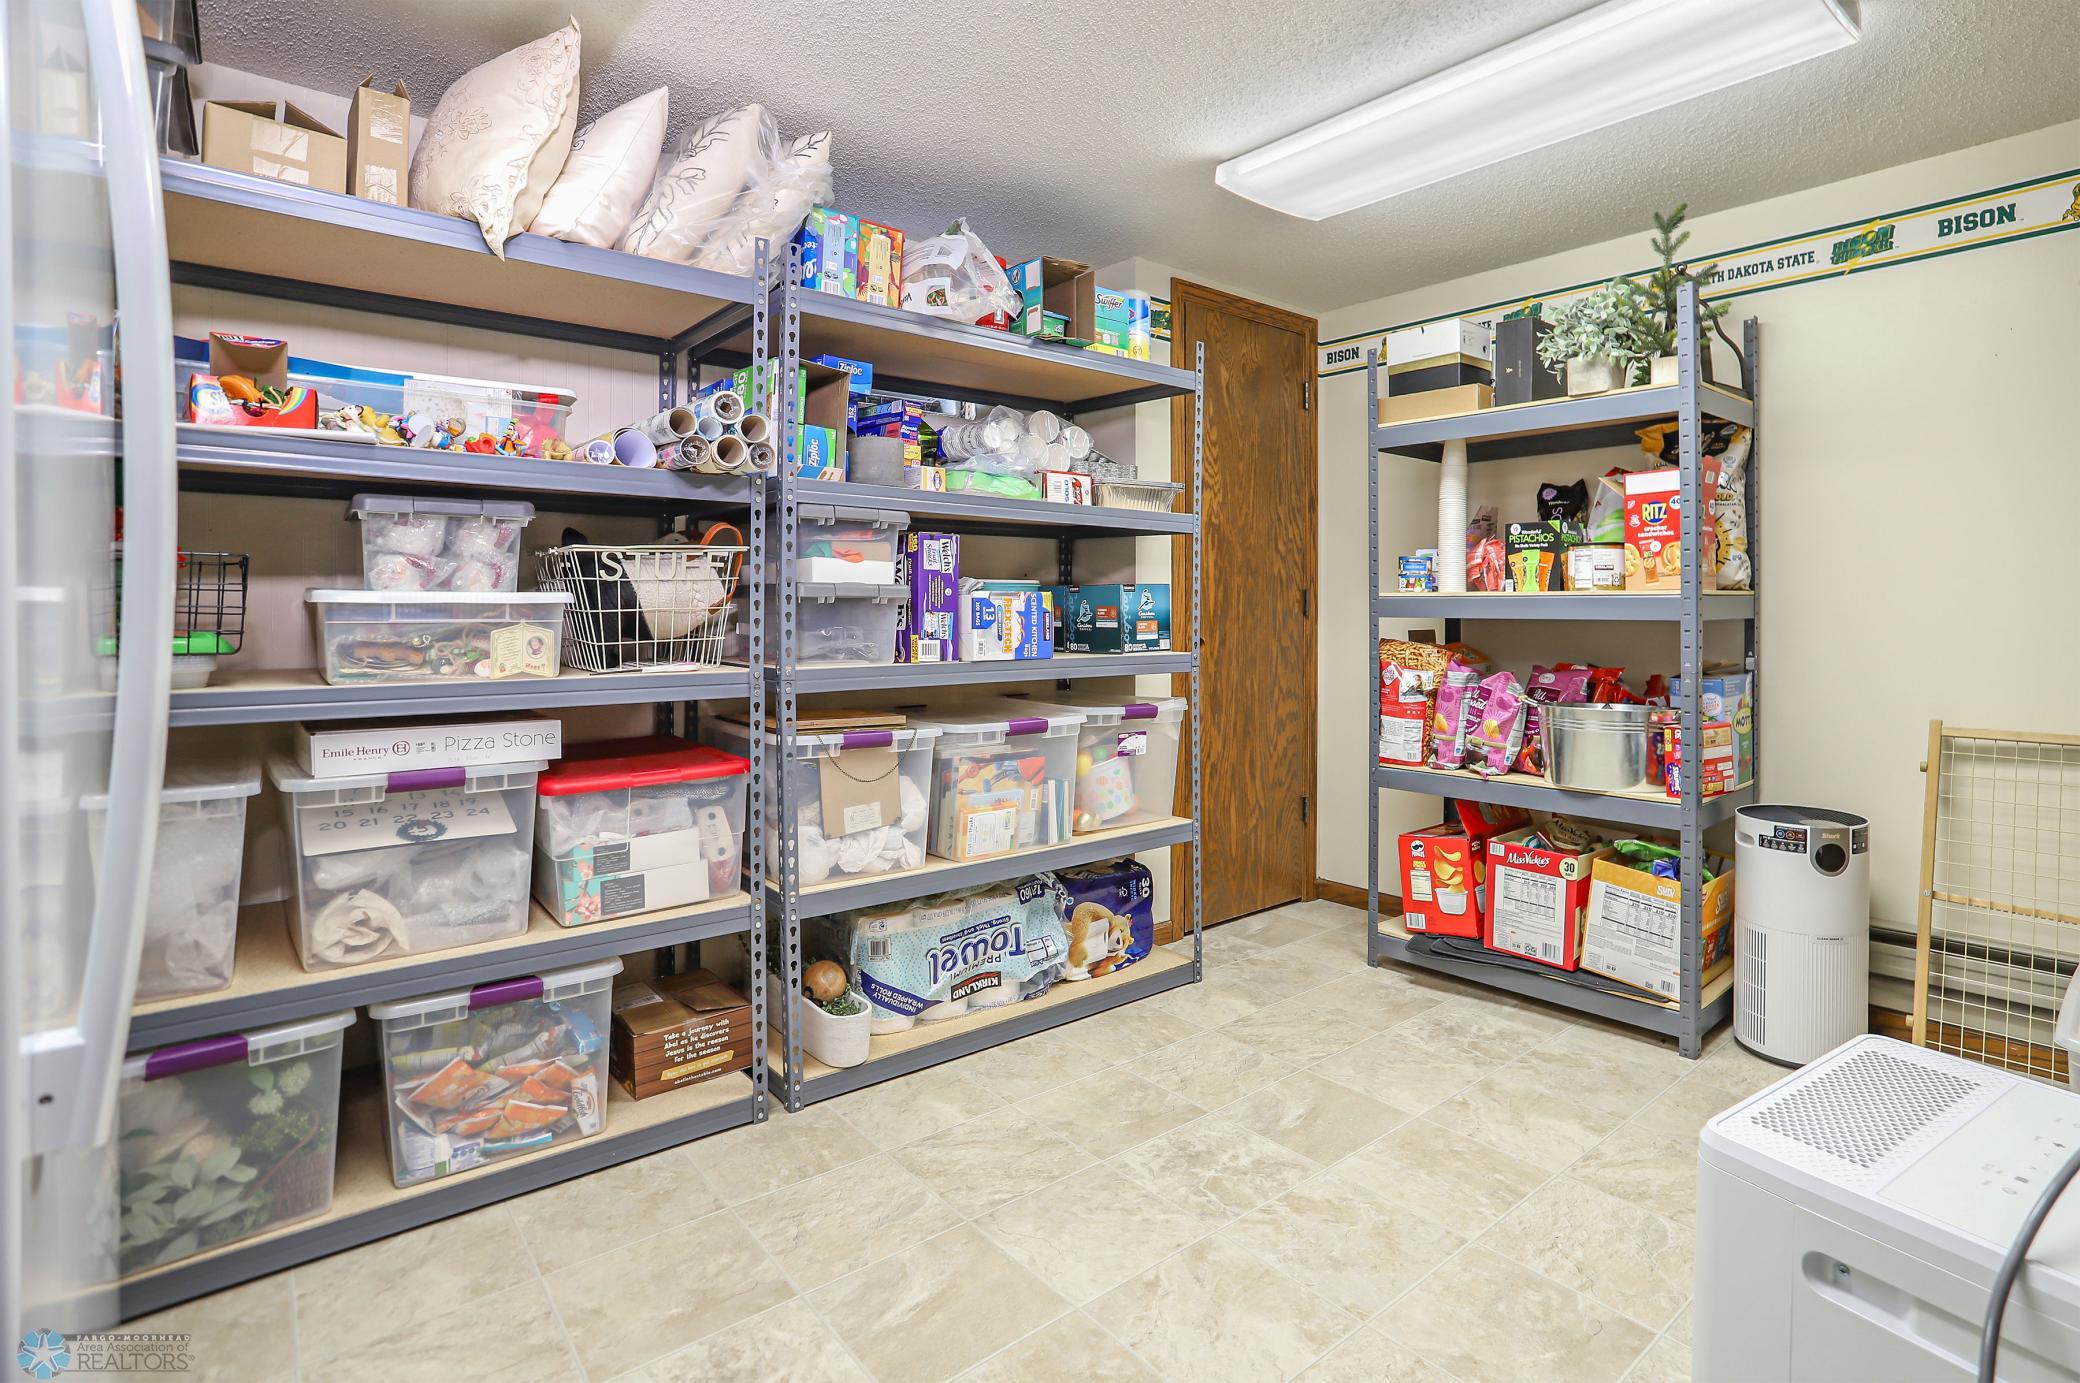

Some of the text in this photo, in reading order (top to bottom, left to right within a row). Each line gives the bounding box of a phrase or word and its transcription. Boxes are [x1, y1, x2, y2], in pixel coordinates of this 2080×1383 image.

[1938, 203, 2017, 238] BISON
[1728, 260, 1774, 281] DAKOTA
[1777, 251, 1815, 270] STATE
[1095, 293, 1123, 311] Swiffer
[1327, 347, 1360, 364] BISON
[808, 439, 819, 467] Ziploc
[1642, 503, 1667, 520] RITZ
[1509, 533, 1554, 543] PISTACHIOS
[599, 551, 729, 581] STUFF
[941, 541, 951, 572] Welch's
[985, 606, 994, 621] 13
[1070, 643, 1078, 651] 80
[1124, 643, 1132, 652] 80
[444, 736, 495, 752] Pizza
[503, 731, 556, 748] Stone
[322, 746, 389, 759] Emile Henry
[334, 797, 477, 818] 15 16 17 18 19
[319, 807, 490, 832] 20 21 22 23 24
[1564, 862, 1575, 874] 30
[1142, 878, 1150, 898] 30
[927, 924, 1027, 986] Towel
[870, 983, 924, 1010] WRAPPED ROLLS
[952, 976, 999, 999] KIRKLAND
[872, 992, 917, 1013] INDIVIDUALLY
[664, 1032, 680, 1042] Take
[688, 1024, 714, 1037] journey
[716, 1019, 729, 1027] with
[664, 1040, 679, 1050] Abel
[700, 1027, 730, 1039] discovers
[665, 1048, 685, 1057] Jesus
[707, 1036, 729, 1046] reason
[687, 1051, 697, 1060] the
[699, 1046, 721, 1056] season
